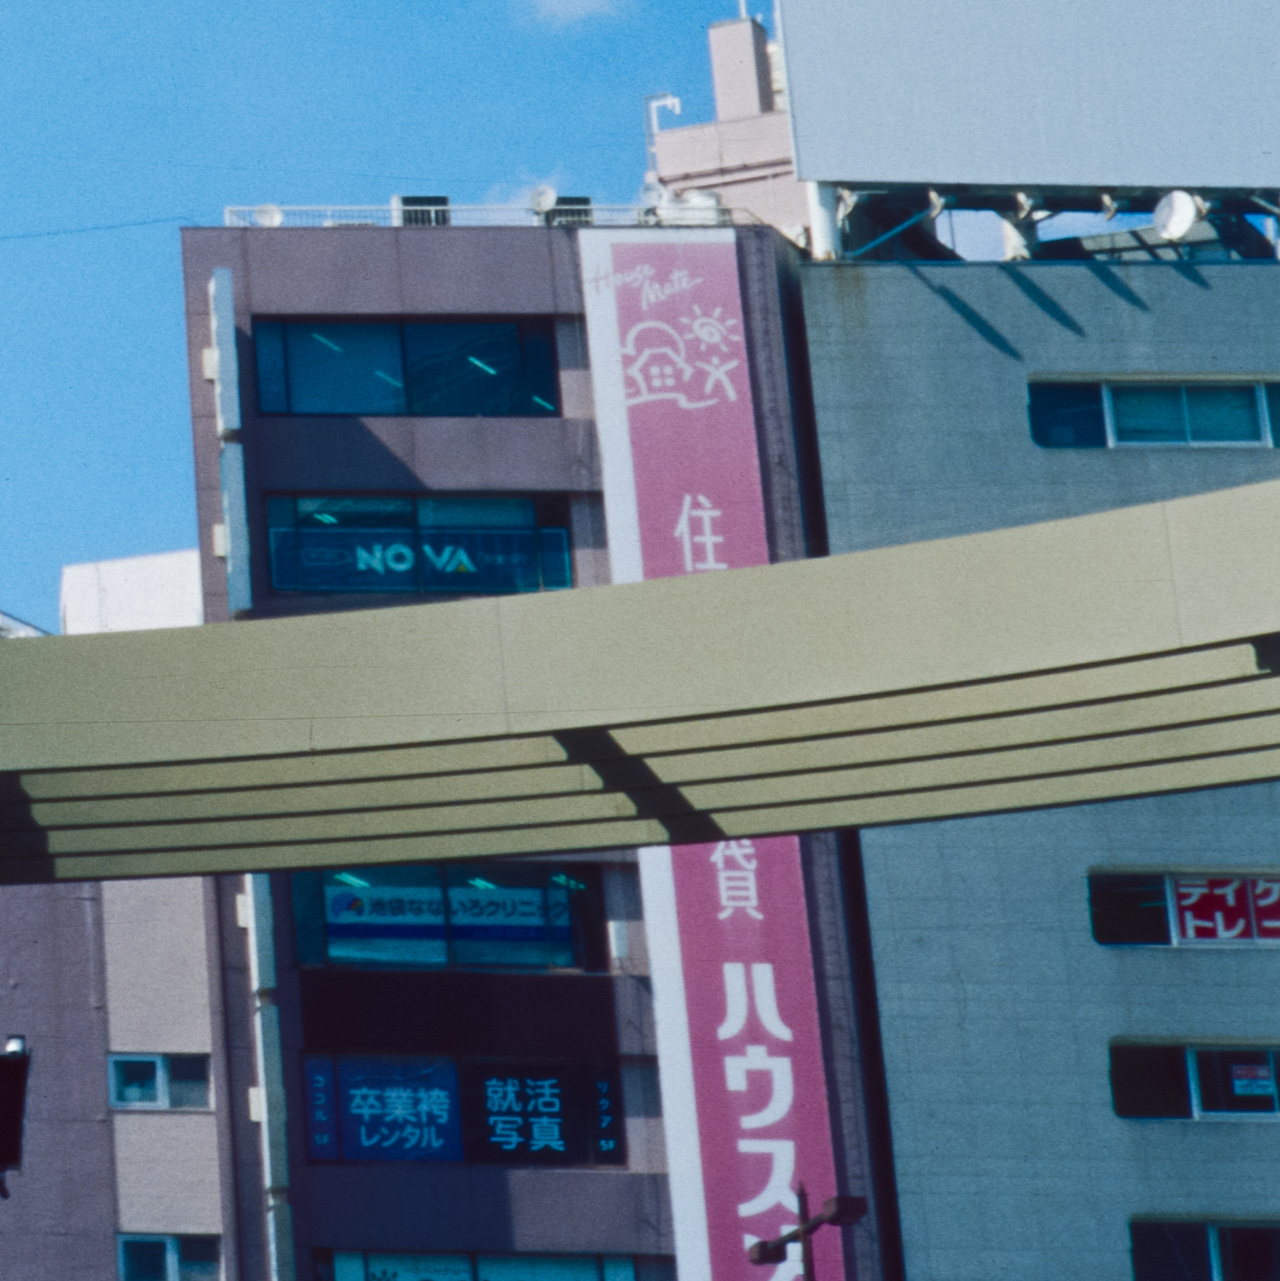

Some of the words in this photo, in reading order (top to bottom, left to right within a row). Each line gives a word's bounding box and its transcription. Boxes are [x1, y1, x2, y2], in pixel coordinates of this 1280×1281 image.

[640, 269, 705, 311] Mate
[354, 542, 479, 575] NOVA
[483, 1076, 562, 1114] 就活
[358, 1124, 445, 1150] レンタル
[487, 1115, 567, 1153] 写真
